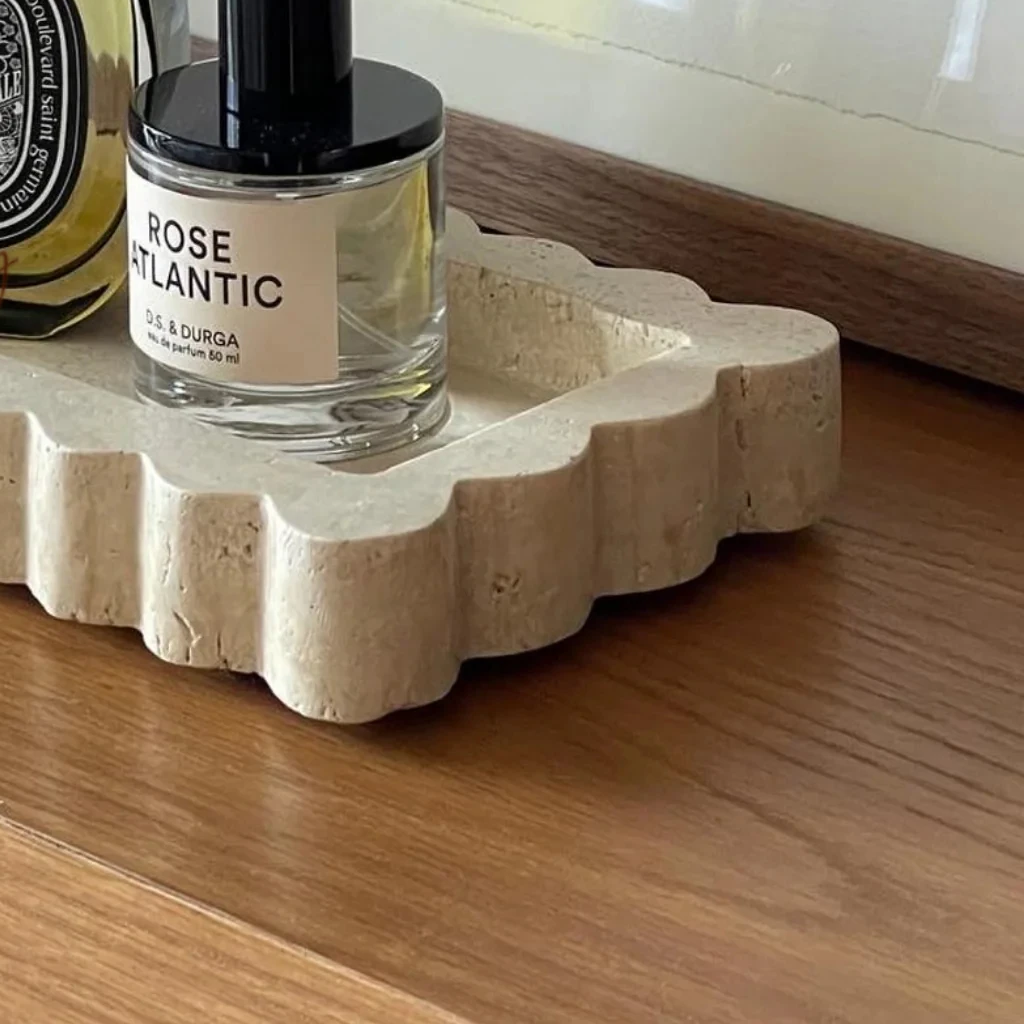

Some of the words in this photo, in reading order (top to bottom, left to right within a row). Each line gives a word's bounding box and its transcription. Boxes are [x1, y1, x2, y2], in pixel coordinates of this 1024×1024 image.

[39, 94, 59, 141] saint
[0, 143, 49, 214] germain
[148, 211, 232, 263] ROSE
[131, 239, 284, 309] ATLANTIC
[146, 308, 166, 331] D.S.
[169, 319, 178, 336] &
[181, 323, 240, 349] DURGA
[172, 343, 207, 359] parfum
[209, 349, 223, 363] 50
[225, 353, 241, 365] ml
